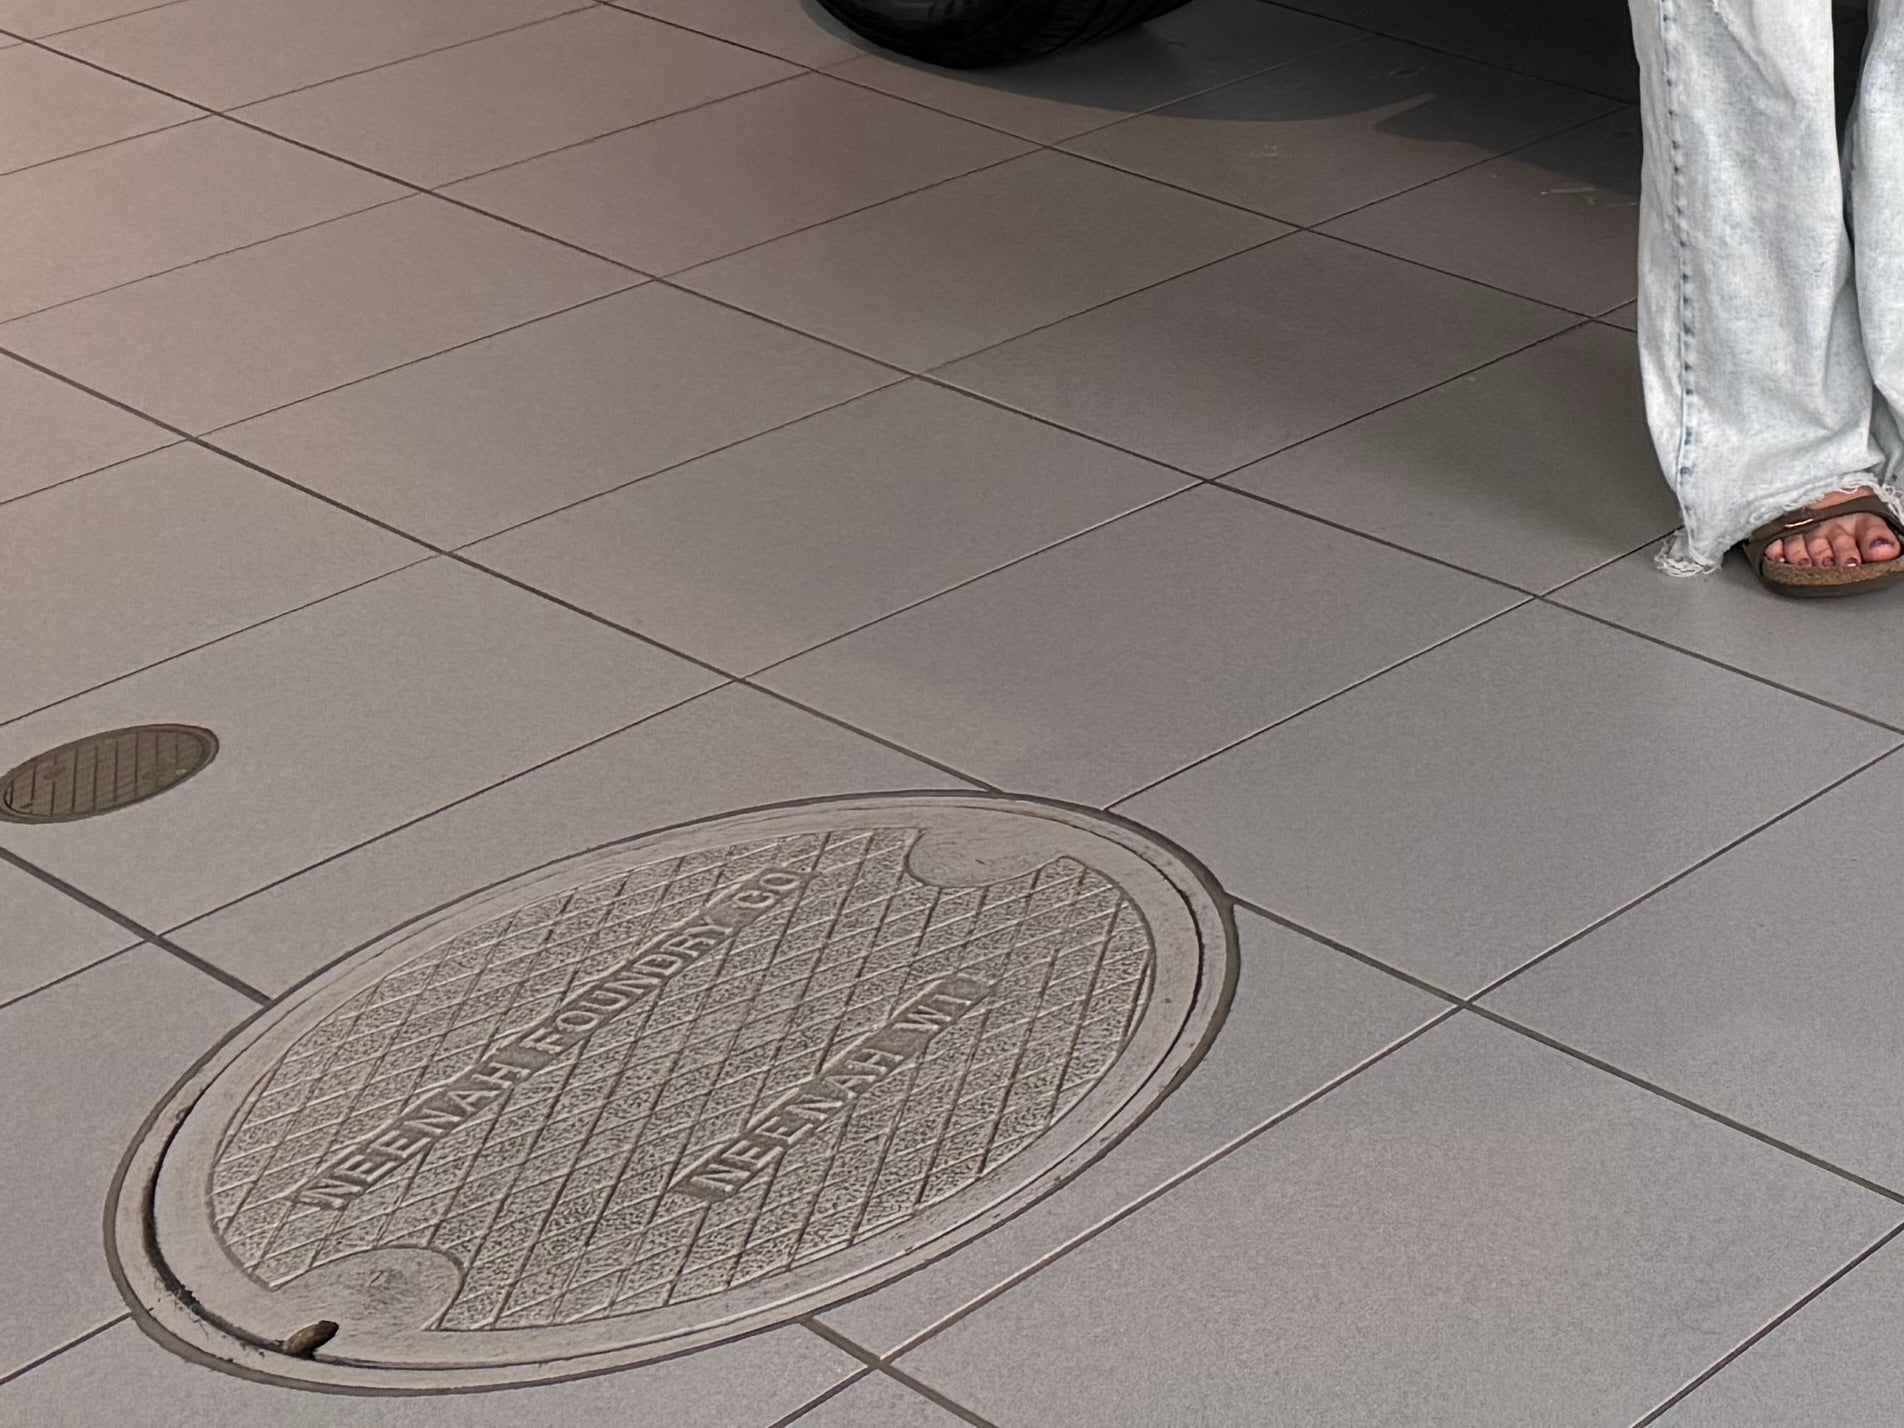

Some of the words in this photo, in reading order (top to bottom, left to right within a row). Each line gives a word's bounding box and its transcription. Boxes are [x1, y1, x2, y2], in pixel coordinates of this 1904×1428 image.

[298, 1061, 533, 1210] NEENAH
[519, 924, 734, 1053] FOUNDRY
[732, 872, 802, 910] CO
[689, 1047, 905, 1194] NEENAH
